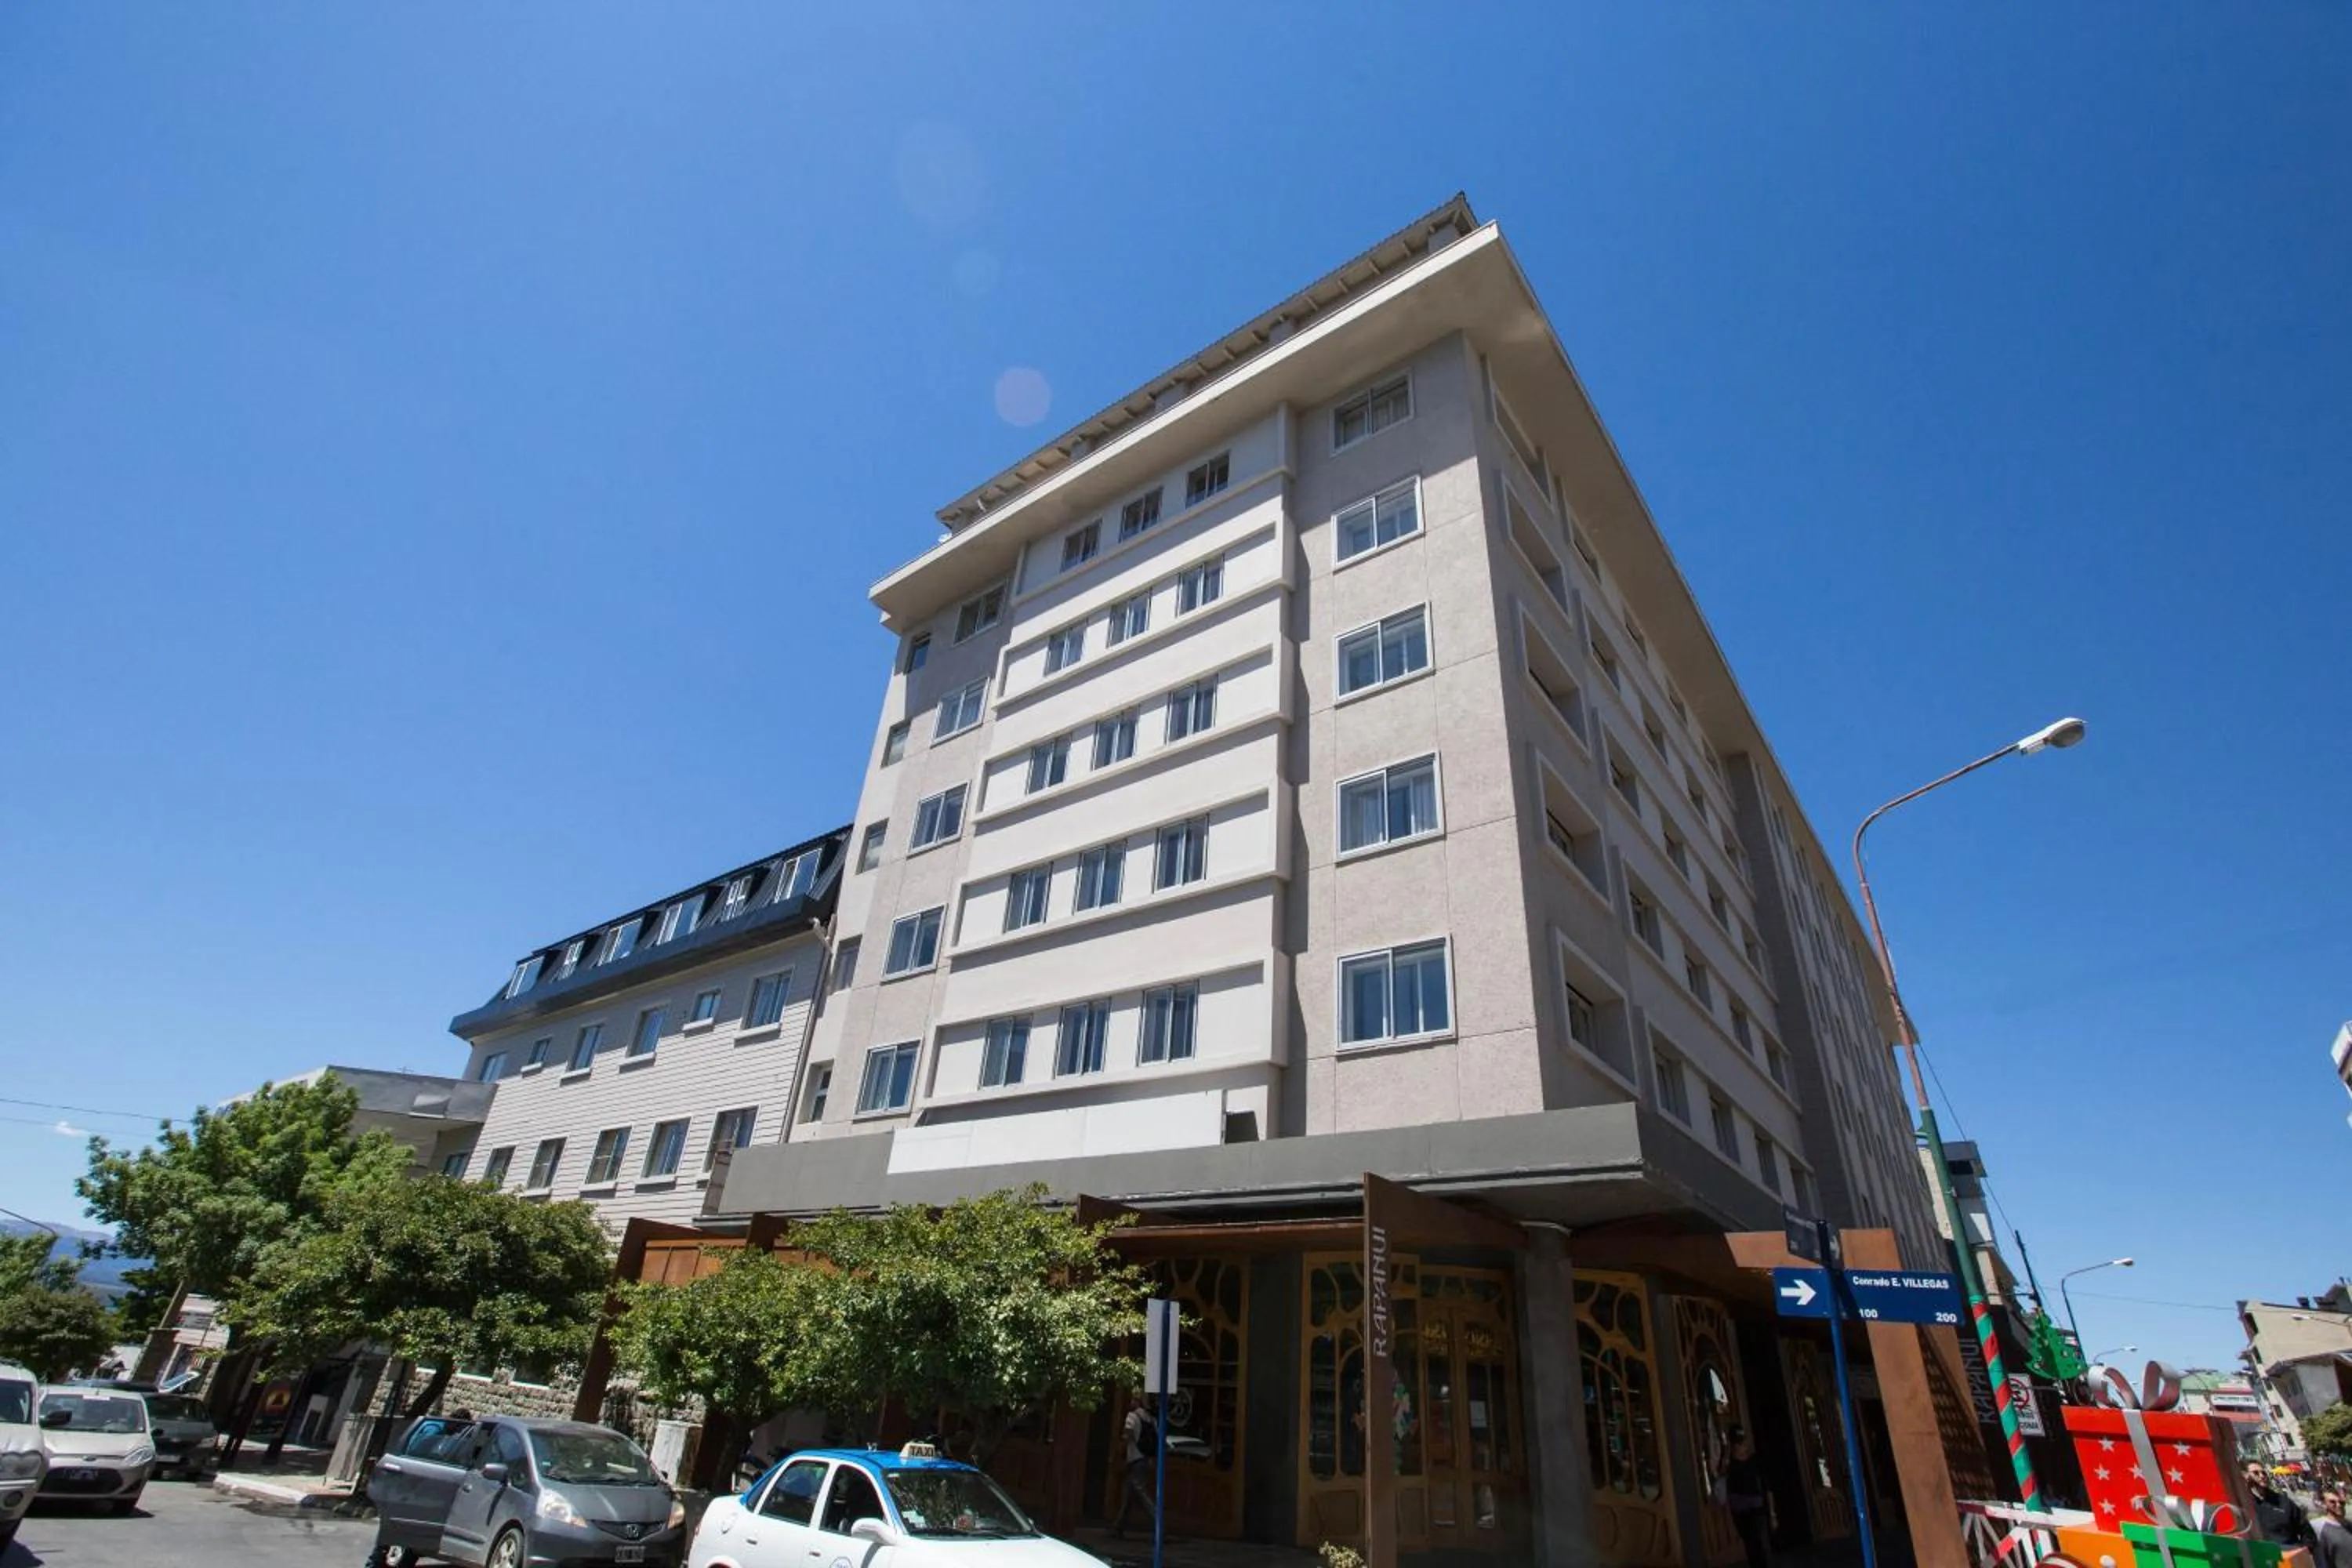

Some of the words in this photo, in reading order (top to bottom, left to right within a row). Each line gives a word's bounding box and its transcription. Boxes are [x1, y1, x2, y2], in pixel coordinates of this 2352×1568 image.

[1853, 1276, 1889, 1287] Conrado
[1891, 1277, 1901, 1287] E.
[1902, 1278, 1950, 1290] VILLEGAS
[1373, 1226, 1387, 1357] RAPANUI
[1859, 1308, 1878, 1319] 100
[1935, 1312, 1958, 1323] 200
[910, 1445, 934, 1457] TAXI
